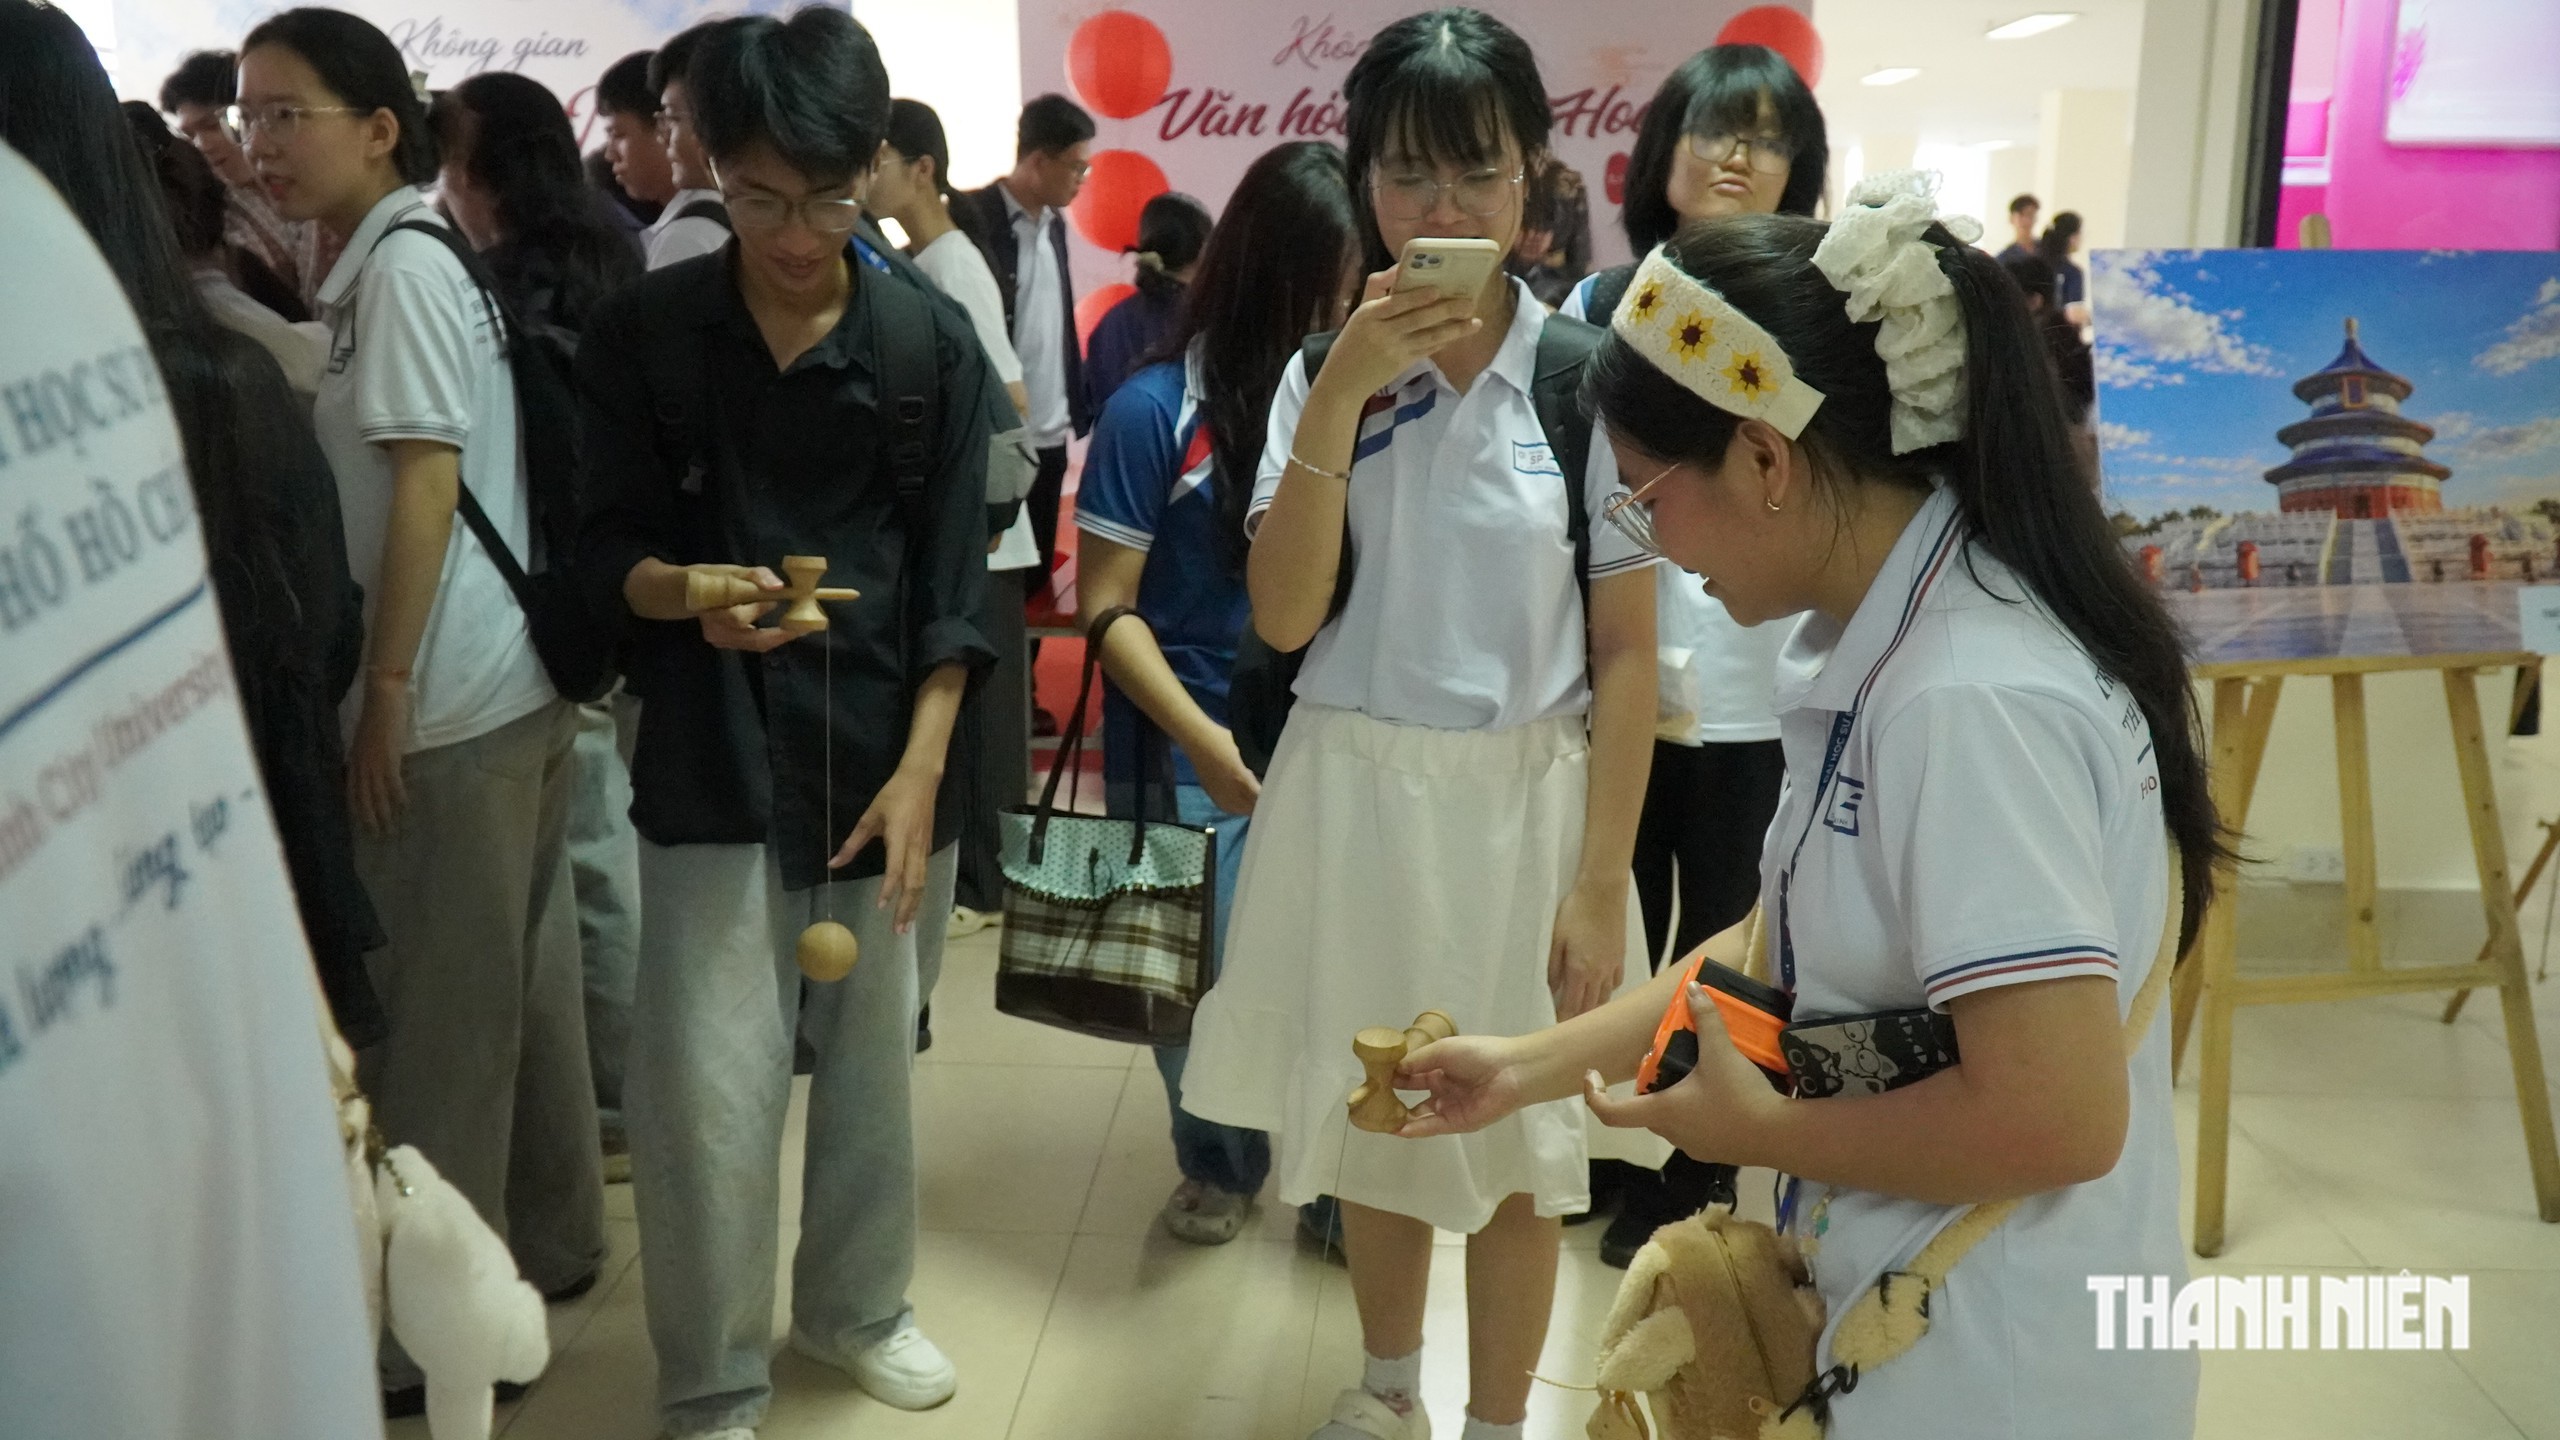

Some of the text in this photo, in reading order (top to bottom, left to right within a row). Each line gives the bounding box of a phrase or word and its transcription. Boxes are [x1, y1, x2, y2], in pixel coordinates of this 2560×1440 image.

[388, 15, 588, 76] Không gian
[1158, 86, 1268, 141] Văn
